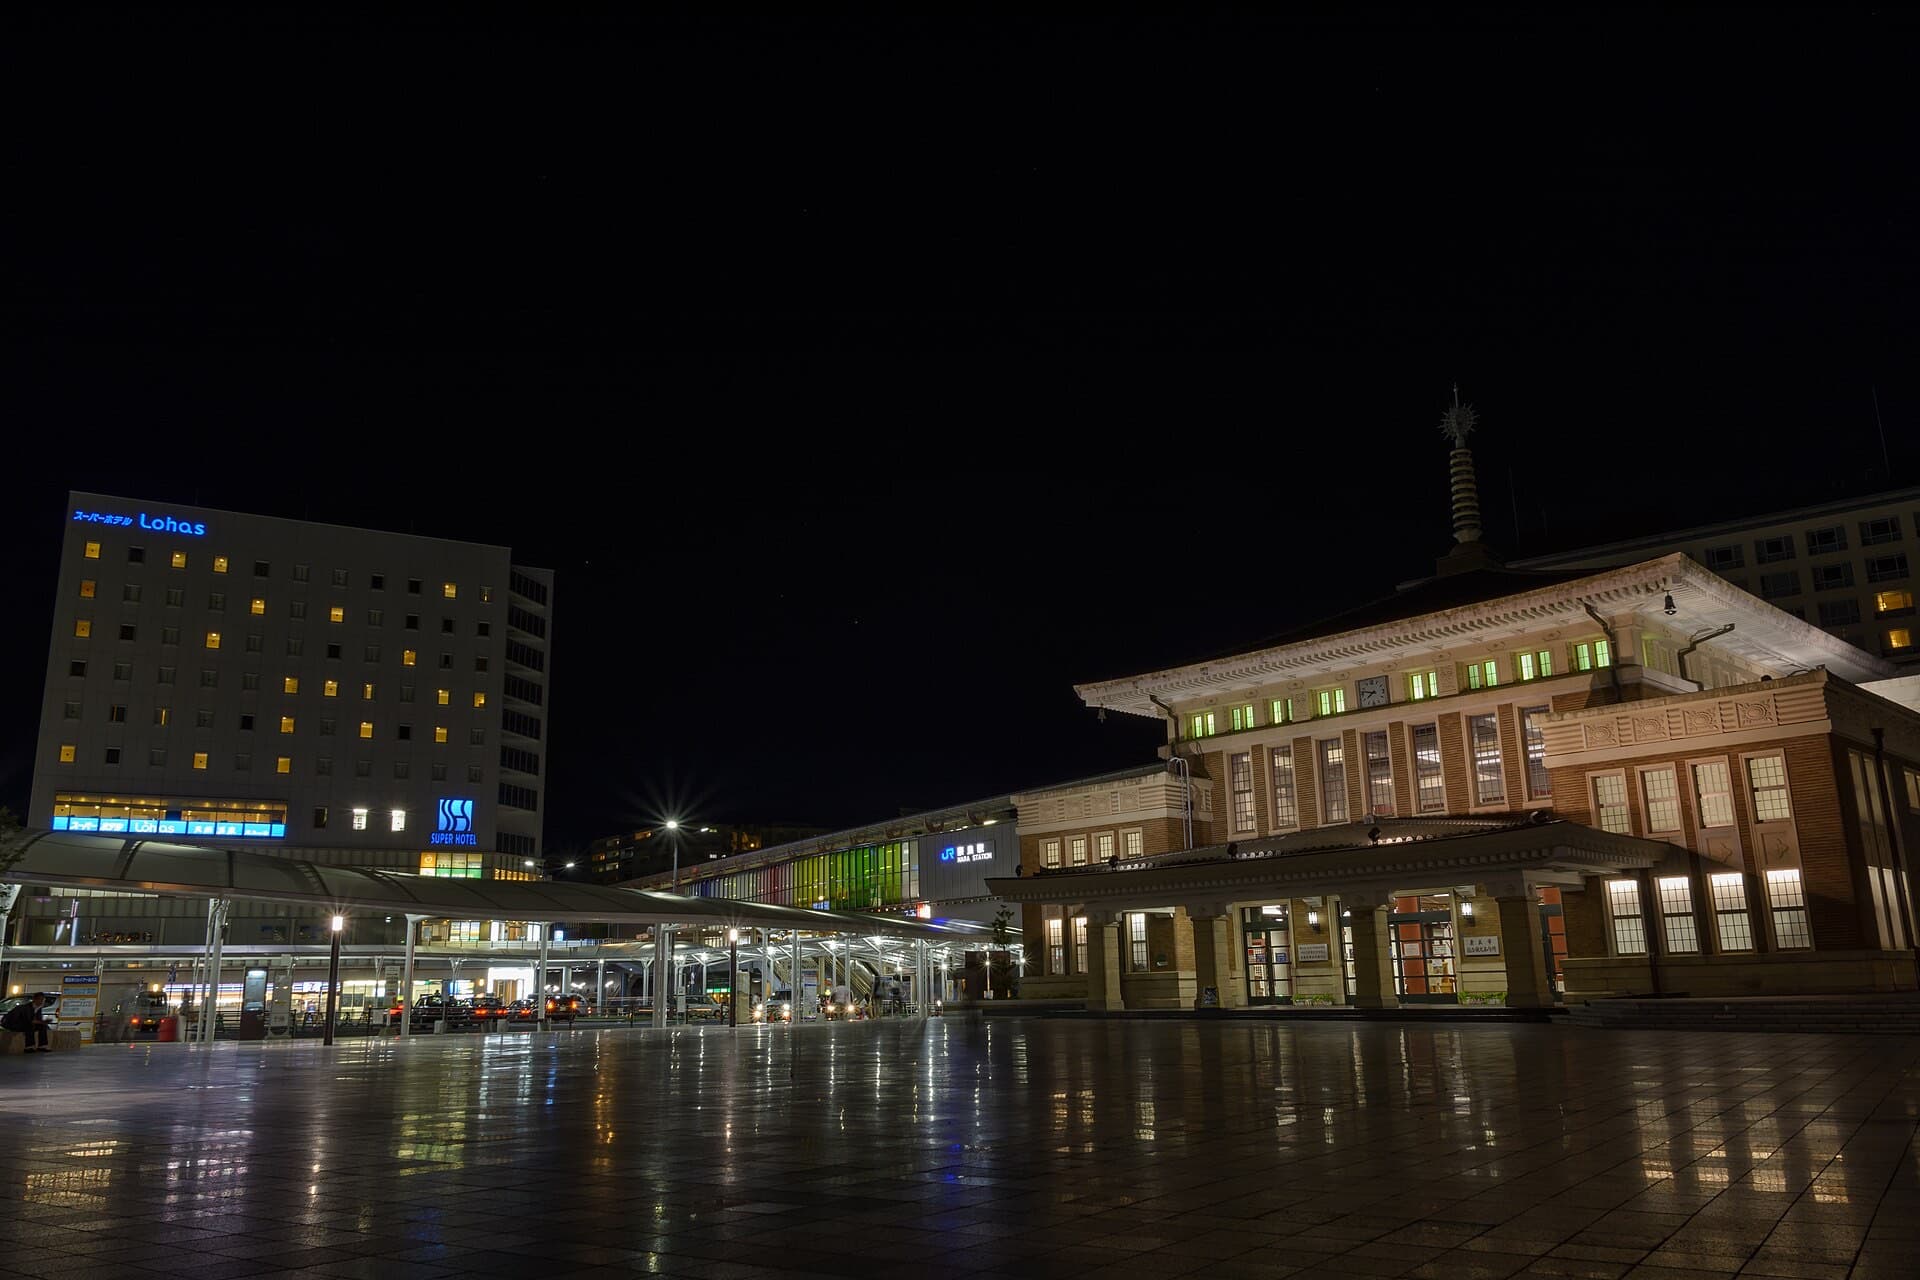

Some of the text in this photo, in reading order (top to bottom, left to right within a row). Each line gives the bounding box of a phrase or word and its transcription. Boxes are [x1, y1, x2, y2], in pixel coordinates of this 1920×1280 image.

[73, 510, 133, 526] スーパーホテル
[140, 513, 206, 536] Lohas
[431, 832, 477, 845] SUPER HOTEL
[941, 847, 954, 861] JR
